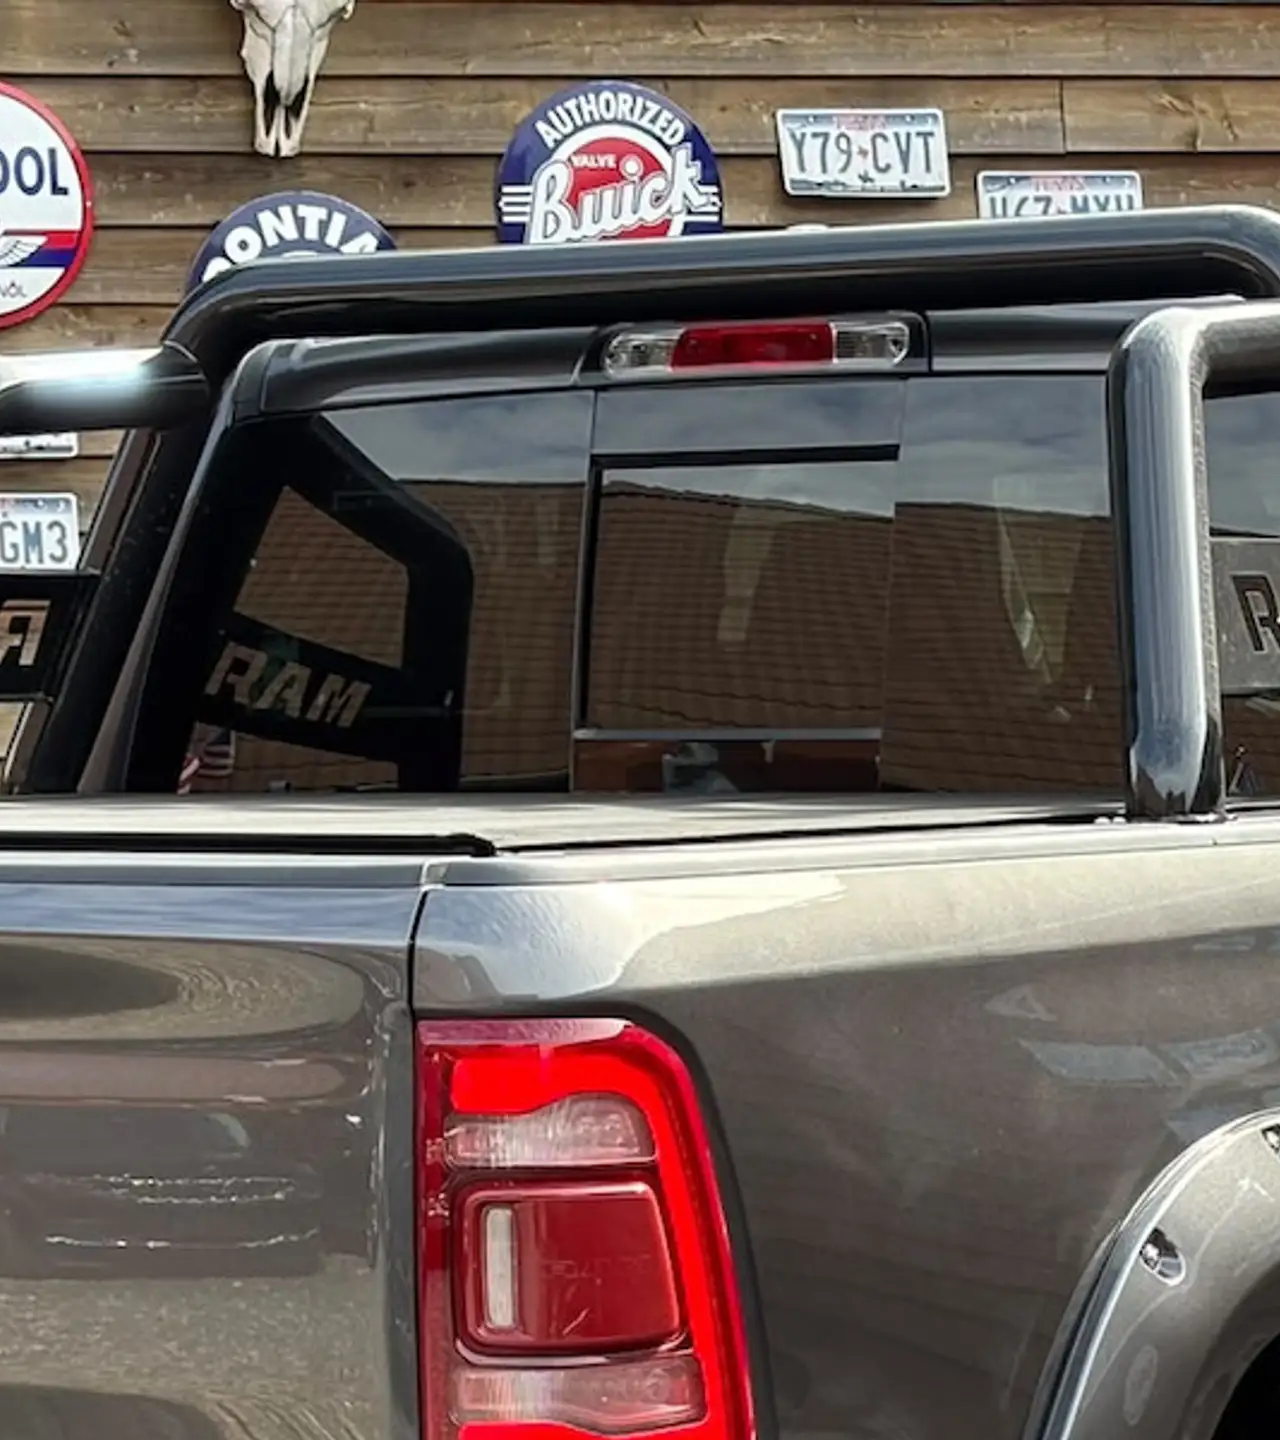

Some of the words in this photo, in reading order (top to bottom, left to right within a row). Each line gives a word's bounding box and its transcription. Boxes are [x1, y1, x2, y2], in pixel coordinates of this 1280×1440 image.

[534, 90, 685, 149] AUTHORIZED
[569, 153, 617, 169] VALVE
[790, 130, 852, 174] Y79
[871, 131, 935, 174] CVT
[525, 142, 711, 244] Buick
[204, 641, 373, 728] RAM
